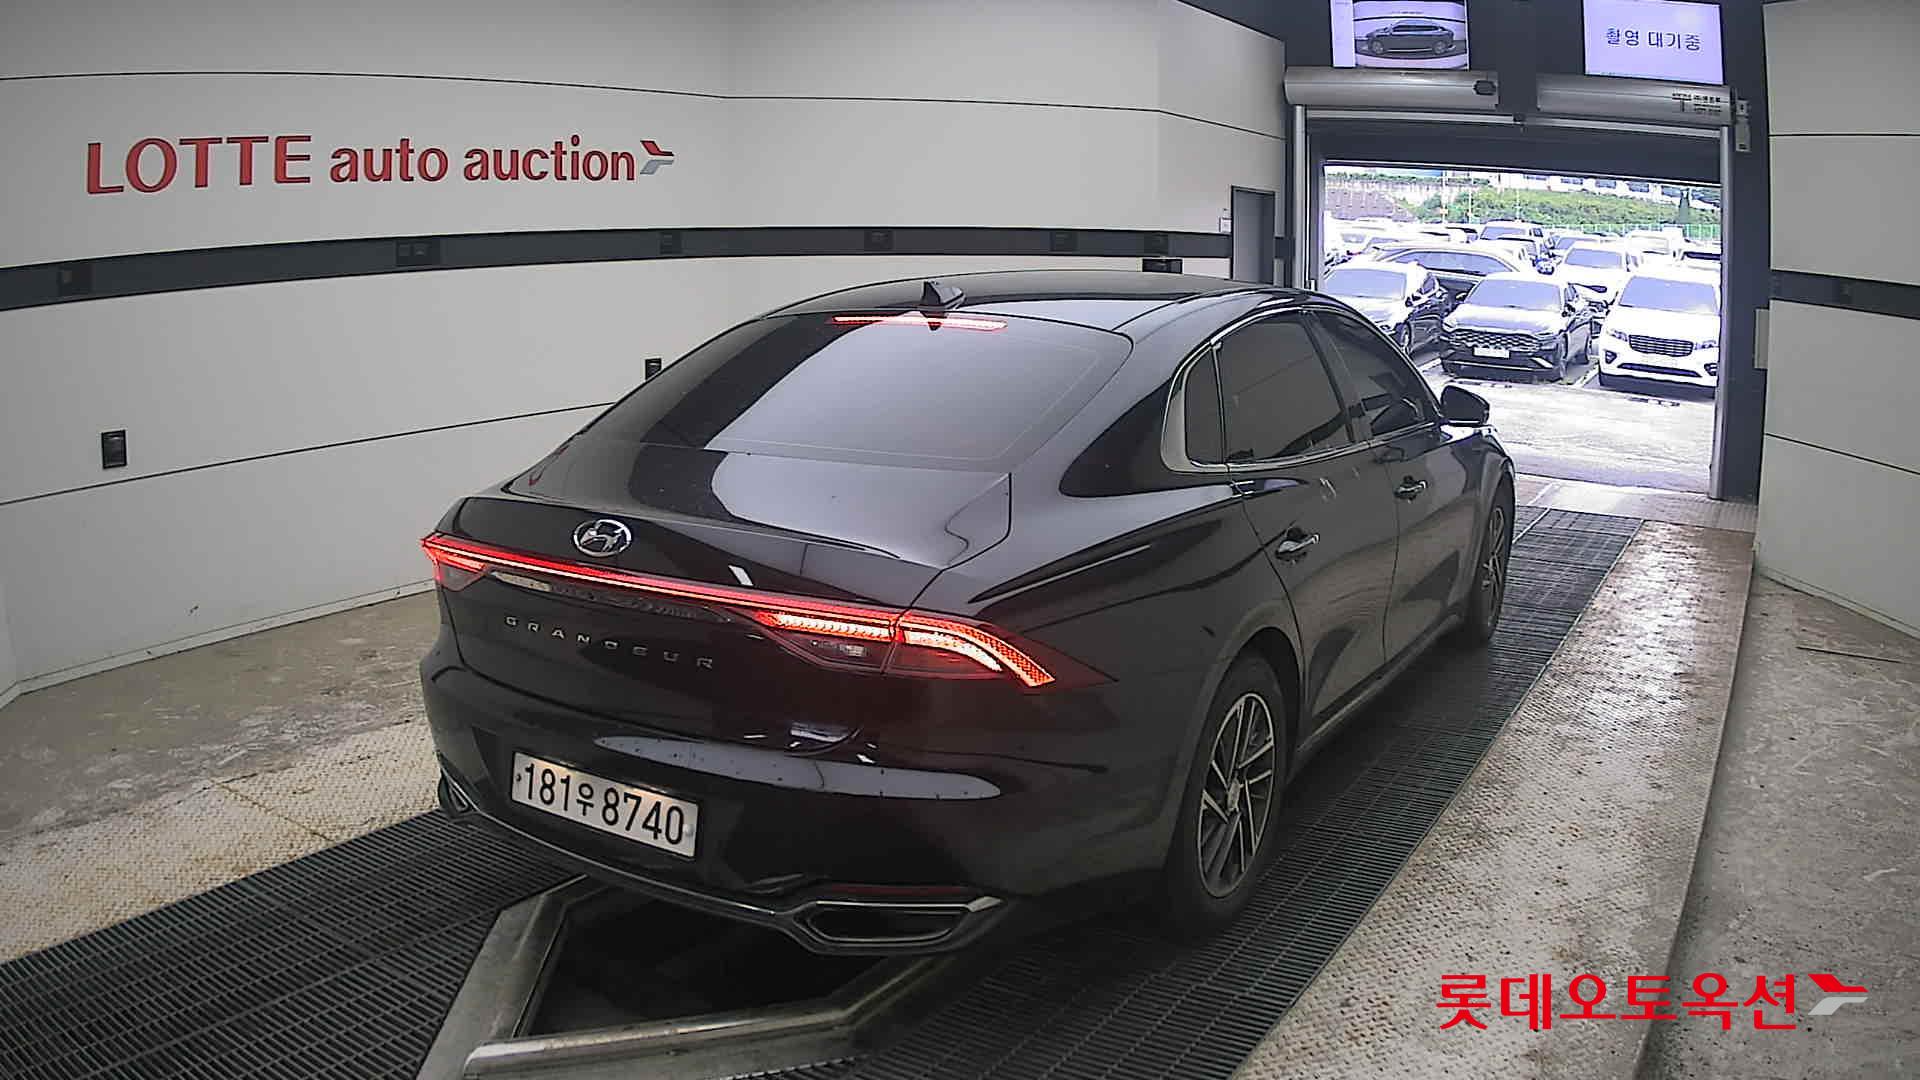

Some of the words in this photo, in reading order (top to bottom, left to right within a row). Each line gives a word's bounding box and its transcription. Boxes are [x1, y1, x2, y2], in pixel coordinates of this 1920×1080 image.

[1647, 31, 1701, 51] 대기중
[87, 135, 312, 195] LOTTE
[329, 137, 449, 183] auto
[463, 134, 636, 181] auction
[504, 615, 714, 670] GRANDEUR
